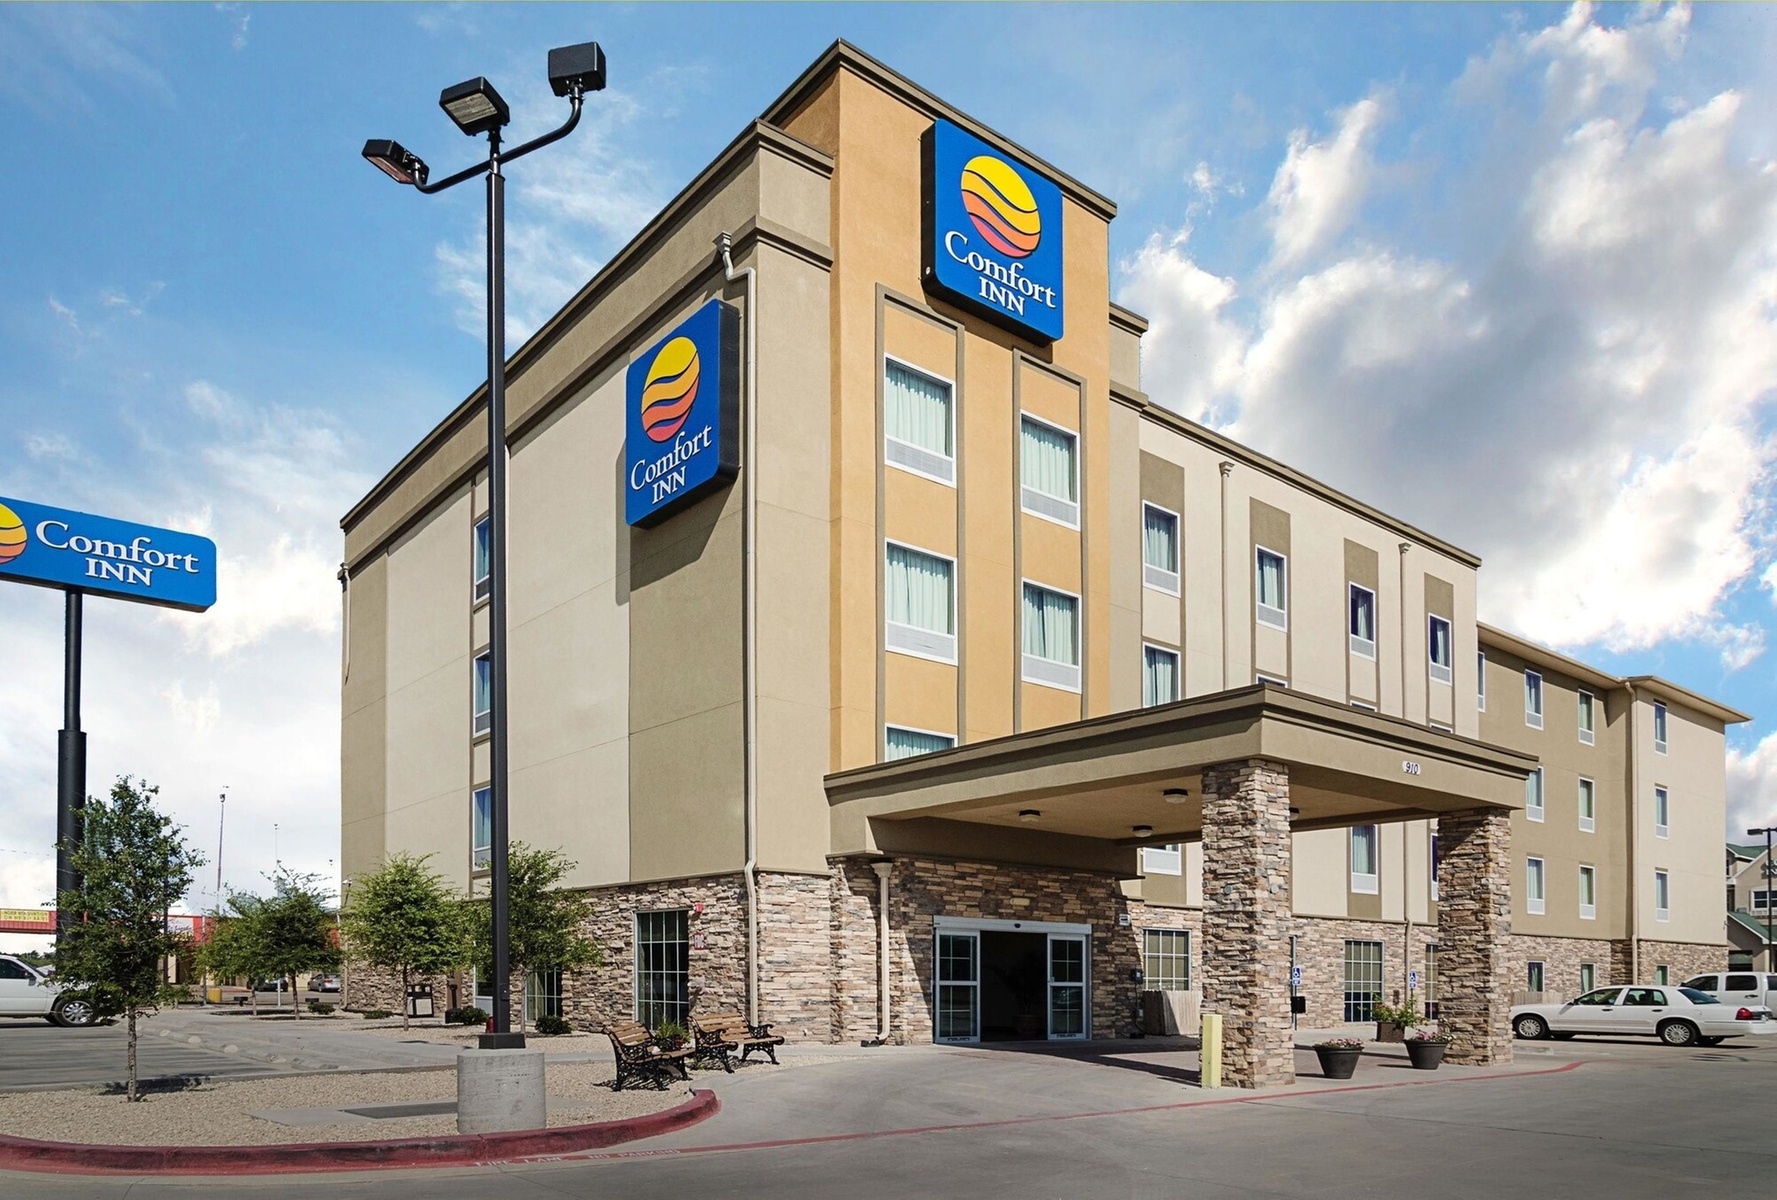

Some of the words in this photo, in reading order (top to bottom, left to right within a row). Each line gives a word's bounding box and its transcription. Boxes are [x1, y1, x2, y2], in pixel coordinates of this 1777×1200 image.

[944, 230, 1056, 308] Comfort
[978, 276, 1025, 316] INN
[630, 424, 712, 491] Comfort
[652, 465, 686, 505] INN
[35, 520, 199, 573] Comfort
[85, 557, 152, 587] INN
[1405, 761, 1418, 774] 910
[588, 1152, 610, 1160] NO
[617, 1148, 681, 1158] PARKING
